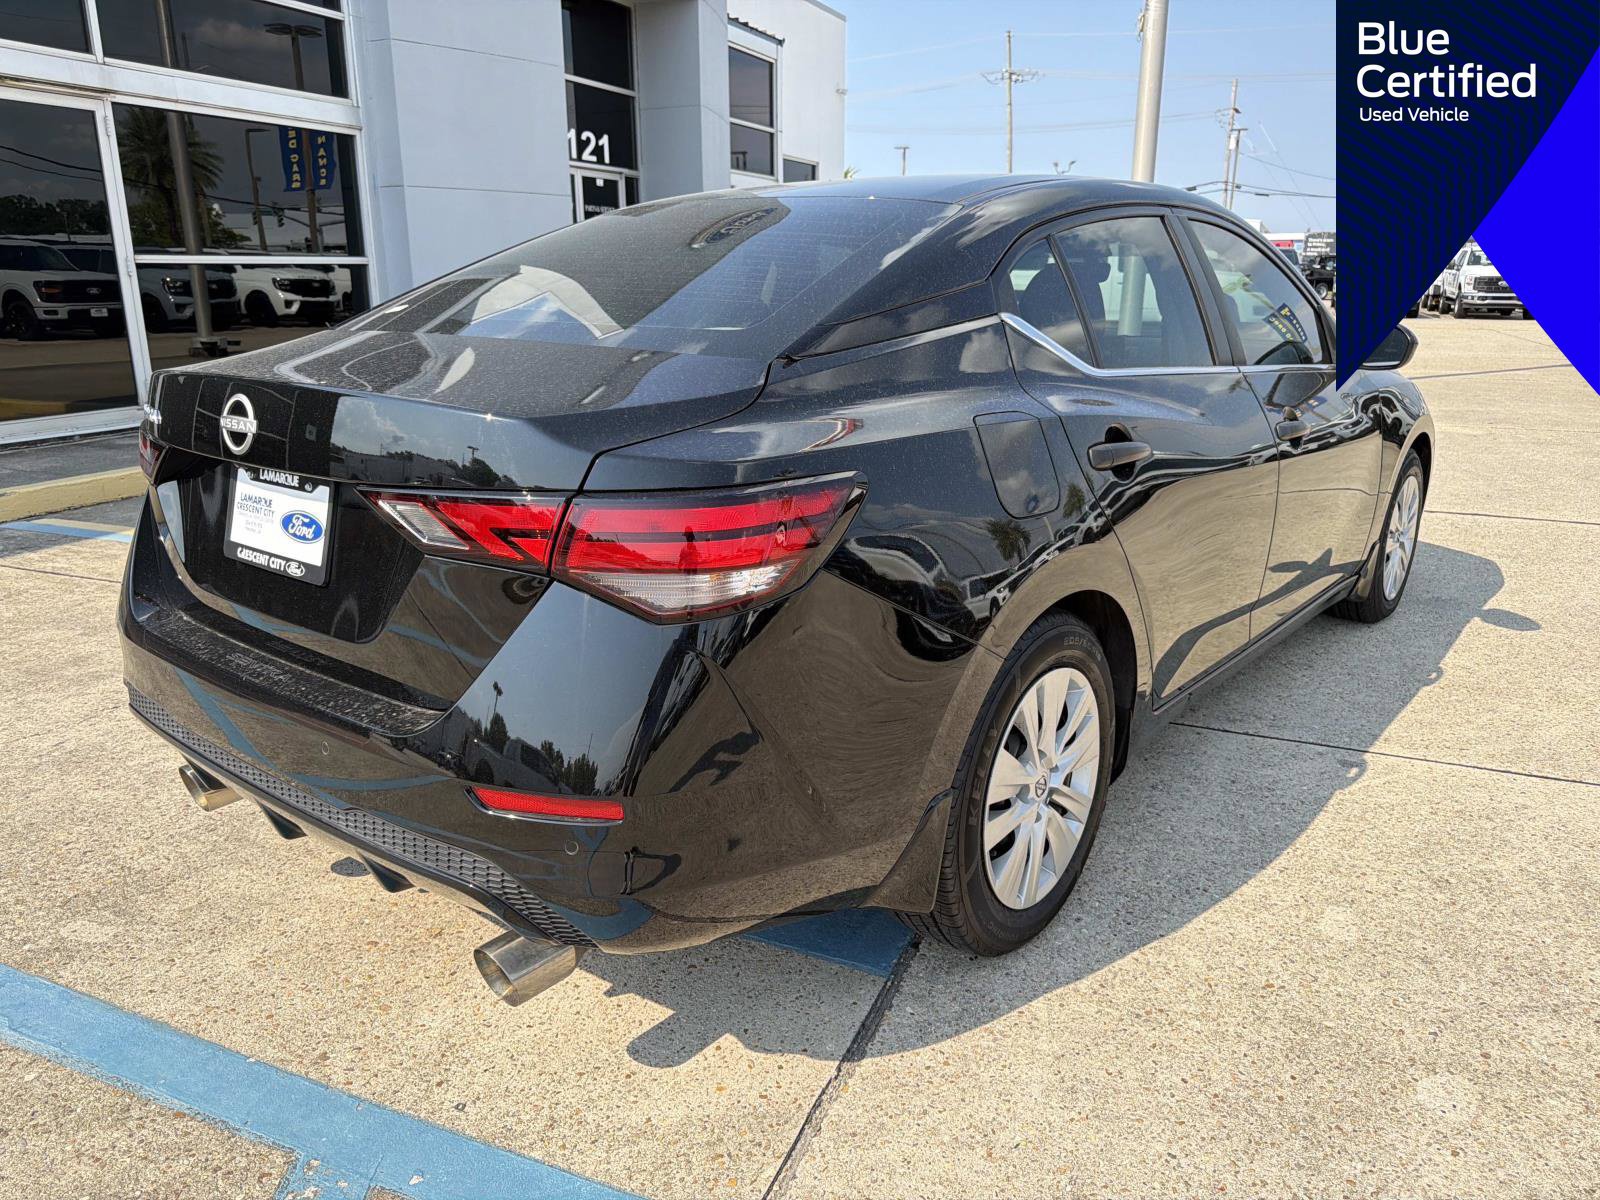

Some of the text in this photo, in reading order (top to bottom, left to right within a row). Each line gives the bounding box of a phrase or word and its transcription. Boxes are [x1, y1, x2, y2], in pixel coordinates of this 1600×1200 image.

[567, 128, 610, 164] 121
[221, 416, 256, 432] NISSAN
[260, 468, 300, 488] LAMARQUE
[236, 501, 263, 516] CRESCENT
[263, 508, 276, 519] CITY
[237, 546, 287, 572] CRESCENT CITY
